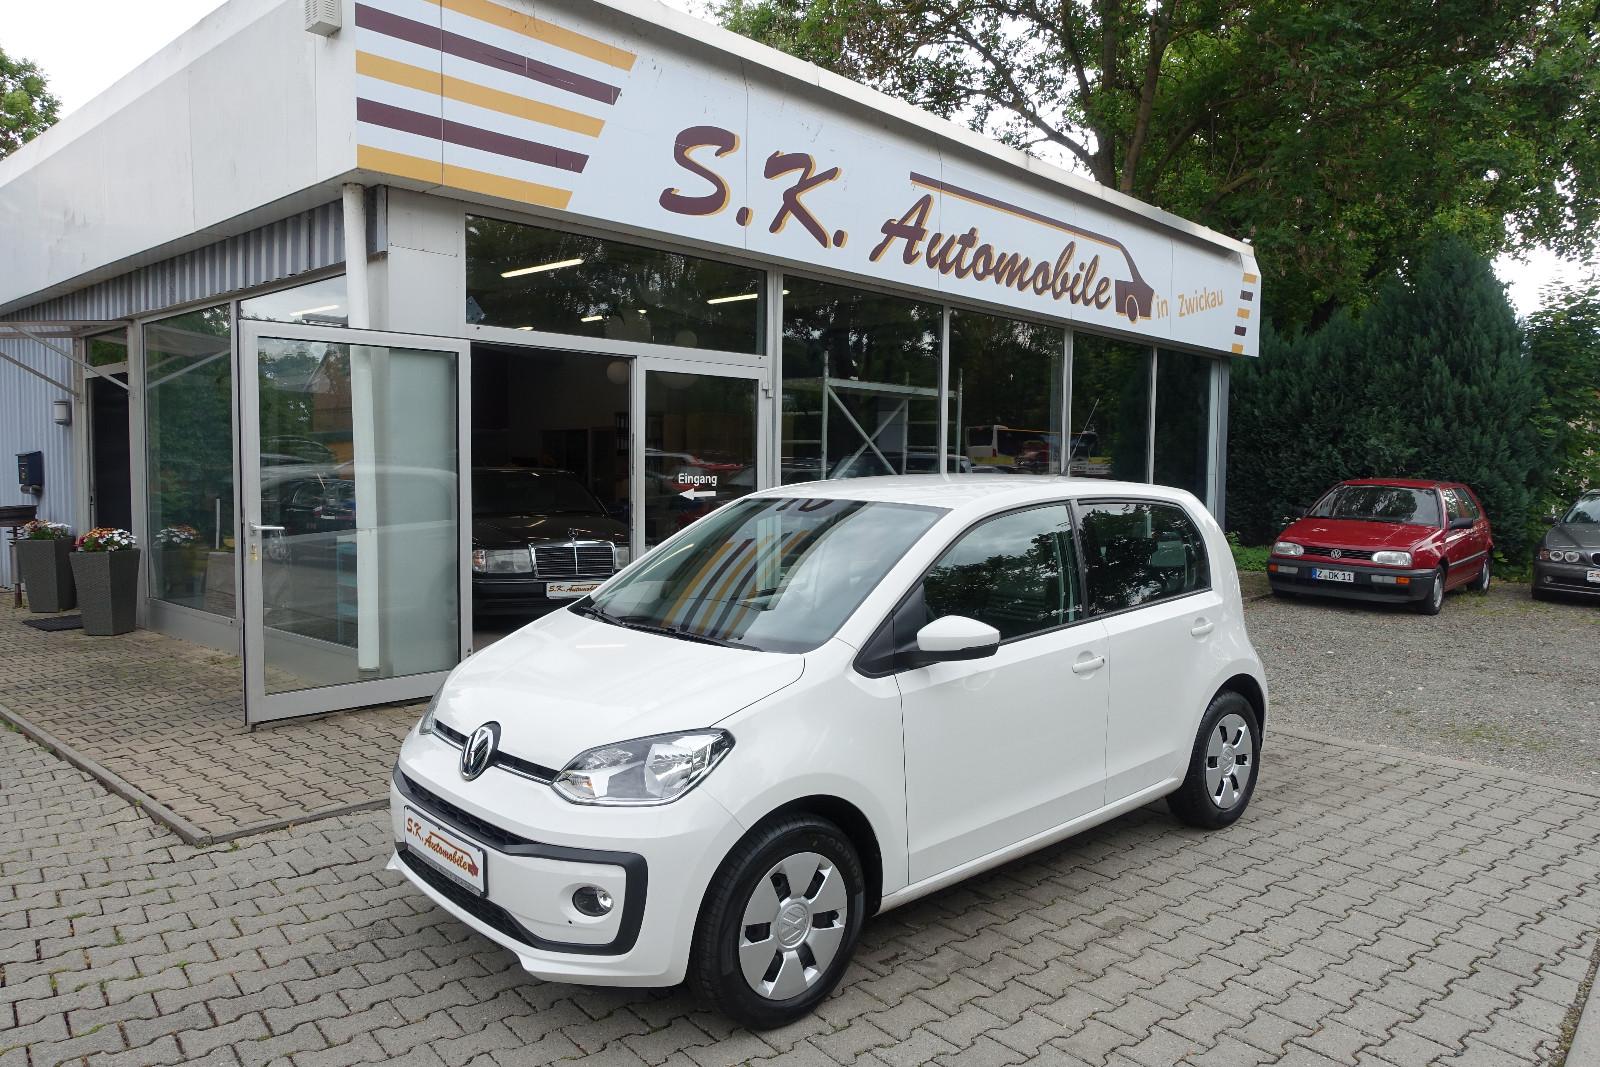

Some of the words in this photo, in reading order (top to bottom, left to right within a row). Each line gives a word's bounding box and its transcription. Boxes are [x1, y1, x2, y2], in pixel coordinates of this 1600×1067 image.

[659, 125, 849, 249] S.K.
[869, 194, 1111, 310] Automobile
[1156, 294, 1168, 318] in
[1177, 287, 1224, 317] Zwickau
[678, 472, 717, 486] Eingang
[406, 817, 423, 842] S.K.
[424, 834, 467, 871] Automobile
